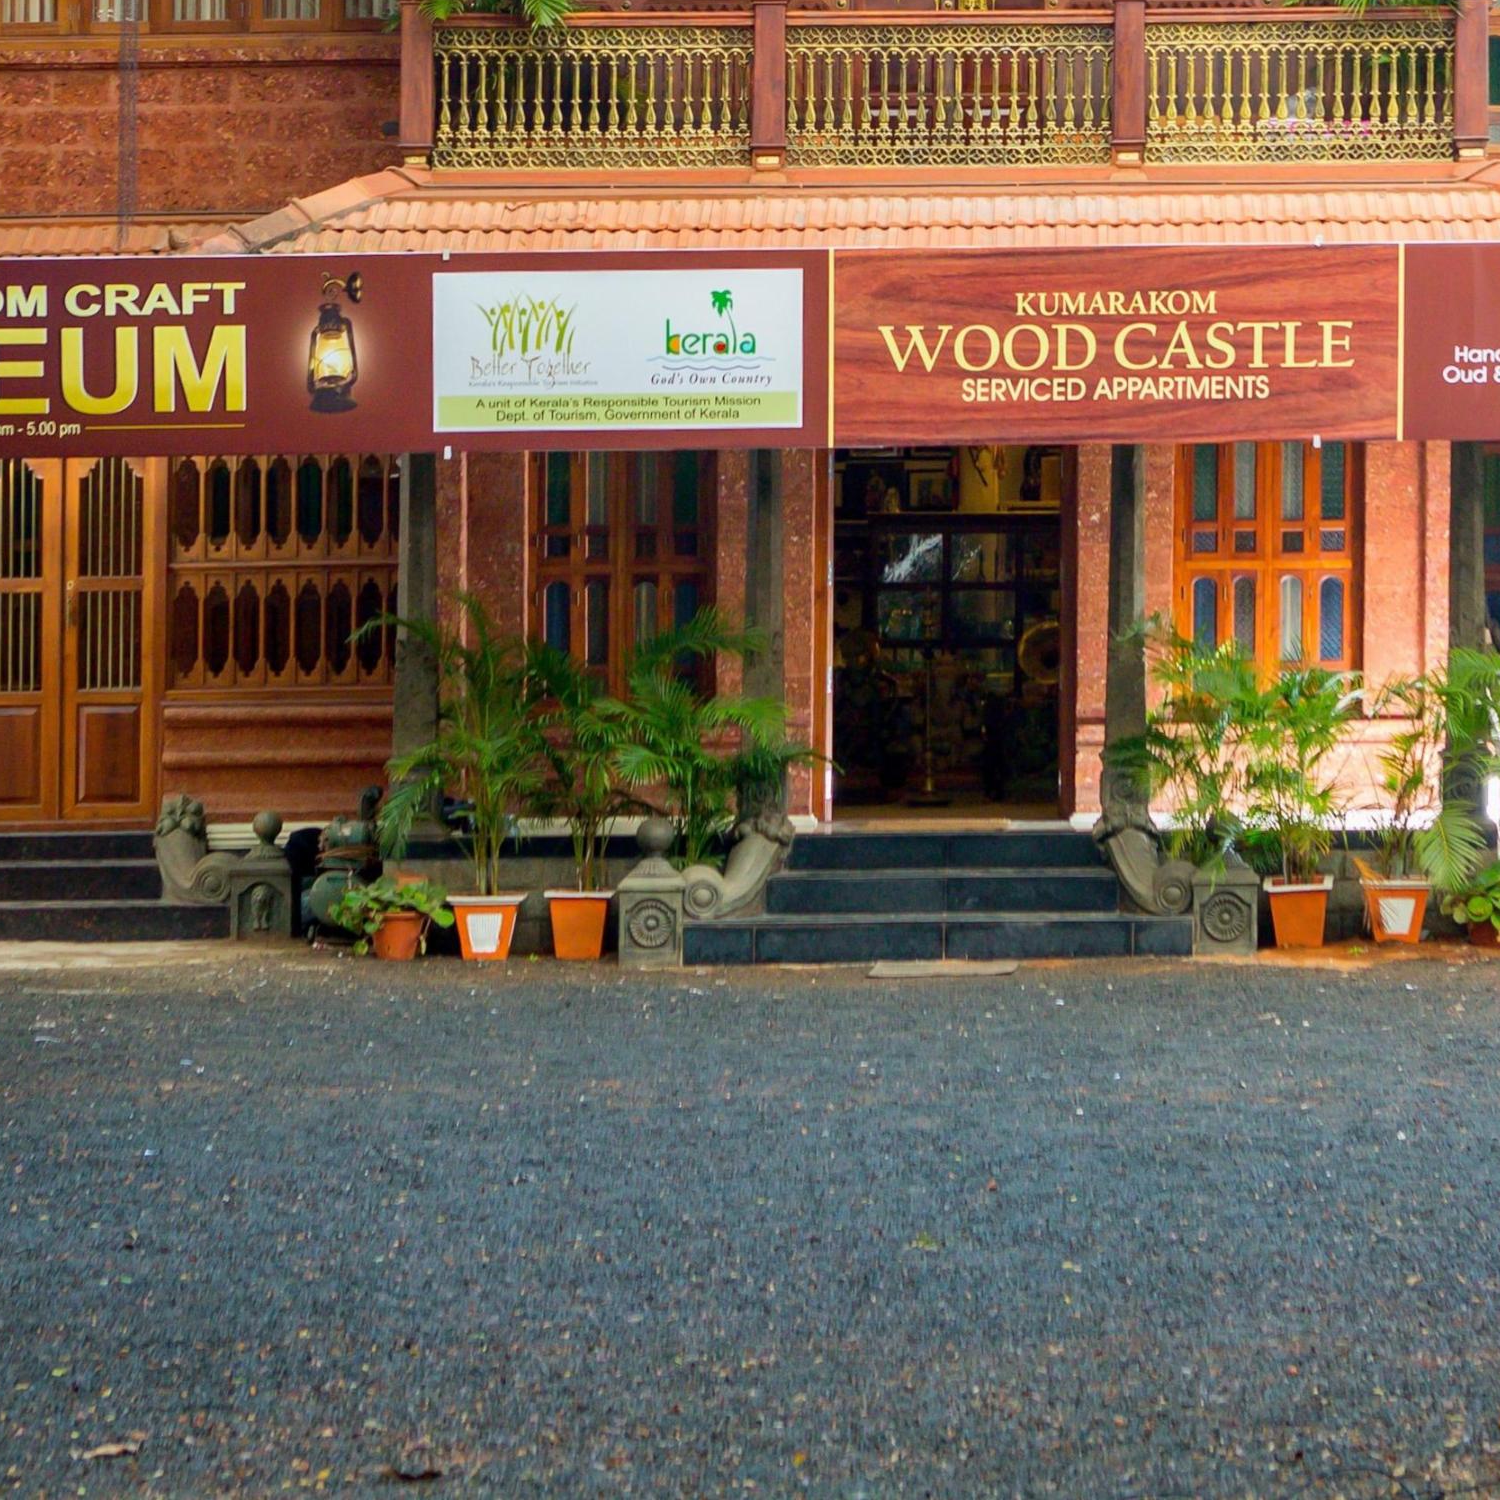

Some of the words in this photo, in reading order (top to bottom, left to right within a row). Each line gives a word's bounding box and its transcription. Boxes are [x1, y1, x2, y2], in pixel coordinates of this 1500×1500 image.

[64, 281, 247, 317] CRAFT
[1015, 290, 1218, 318] KUMARAKOM
[877, 322, 1098, 373] WOOD
[1113, 320, 1355, 371] CASTLE
[688, 372, 717, 385] Own
[721, 371, 773, 387] Country
[1442, 365, 1488, 384] Oud
[961, 377, 1086, 403] SERVICED
[1093, 374, 1271, 401] APPARTMENTS
[475, 398, 486, 409] A
[488, 398, 511, 408] unit
[514, 398, 527, 408] of
[583, 396, 660, 410] Responsible
[663, 396, 712, 407] Tourism
[714, 395, 762, 406] Mission
[496, 409, 527, 423] Dept.
[533, 409, 546, 421] of
[549, 409, 601, 422] Tourism,
[604, 407, 681, 421] Government
[684, 407, 697, 420] of
[699, 407, 740, 420] Kerala
[26, 420, 57, 436] 5.00
[59, 422, 82, 438] pm
